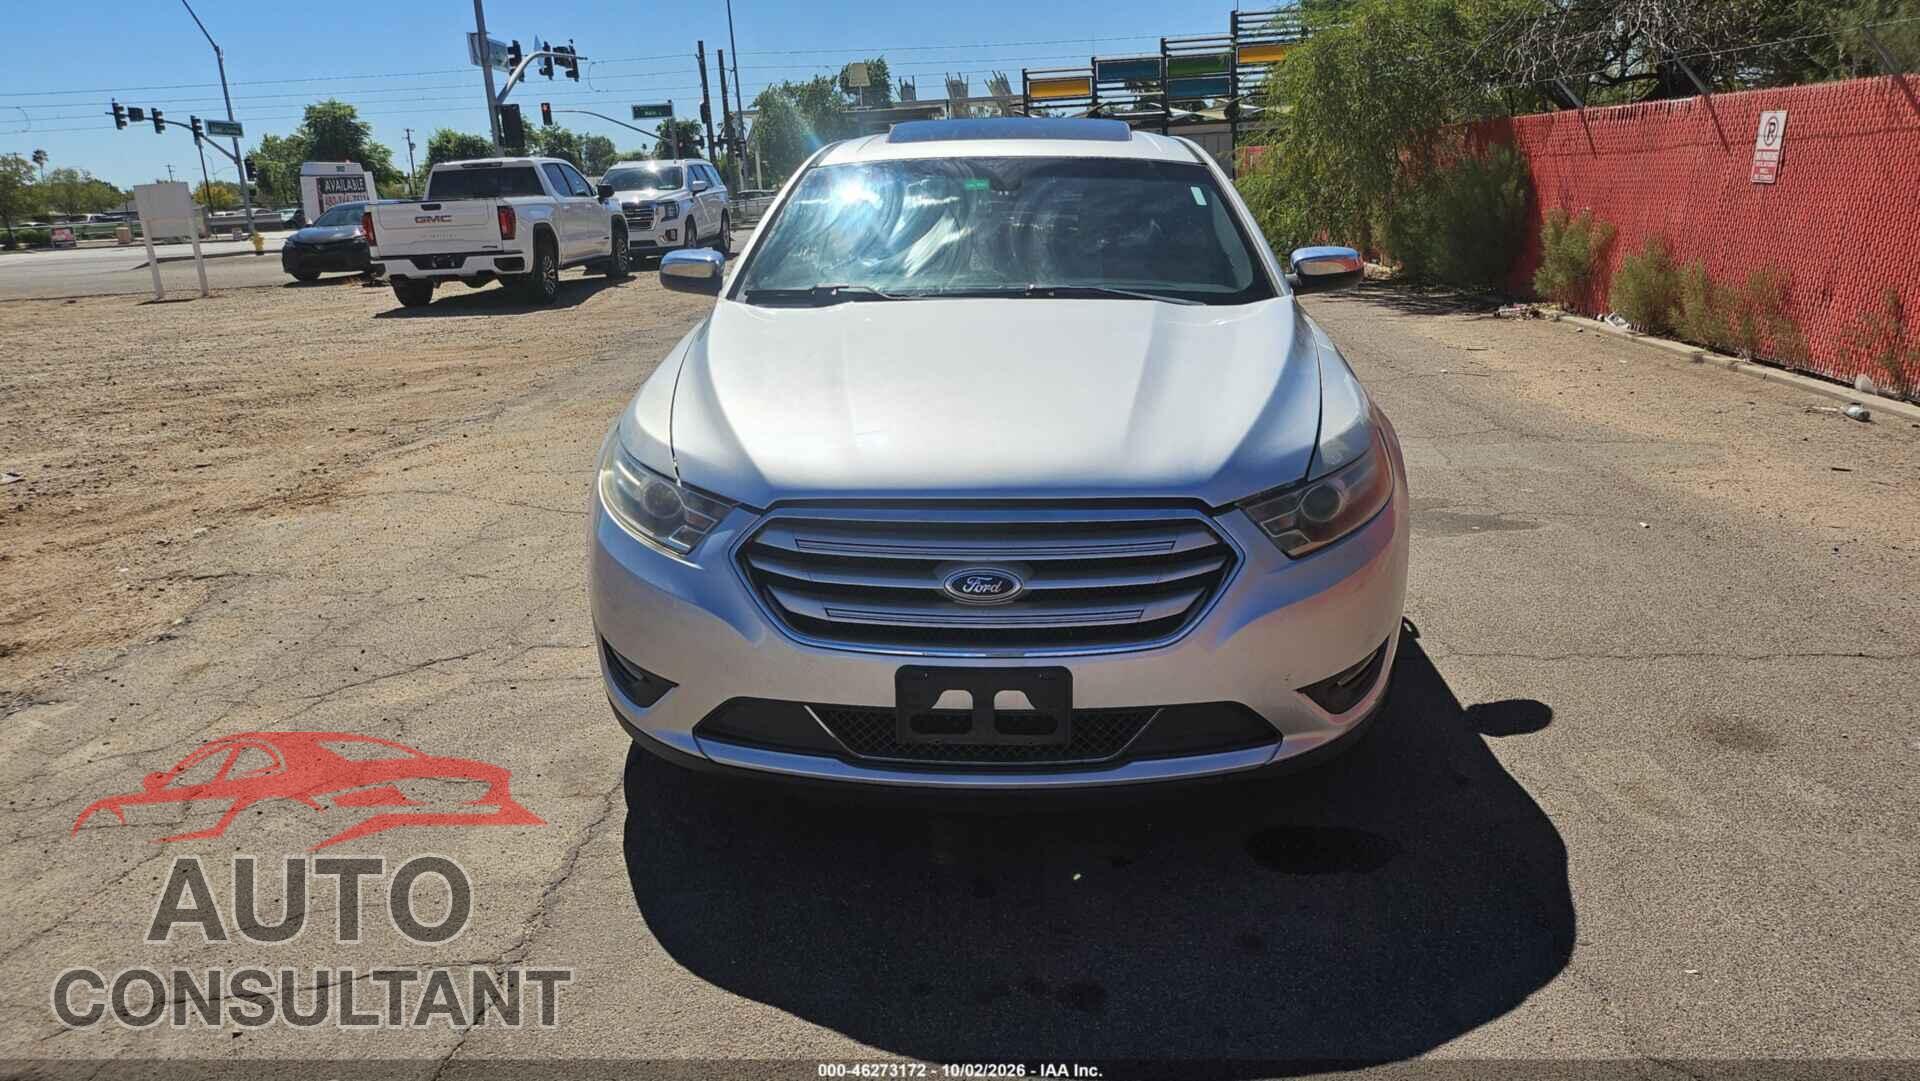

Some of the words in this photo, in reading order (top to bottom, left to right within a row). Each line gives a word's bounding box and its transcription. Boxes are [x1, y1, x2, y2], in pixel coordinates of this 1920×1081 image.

[324, 177, 364, 192] AVAILABLE
[415, 215, 452, 224] GMC
[963, 576, 1002, 592] Ford
